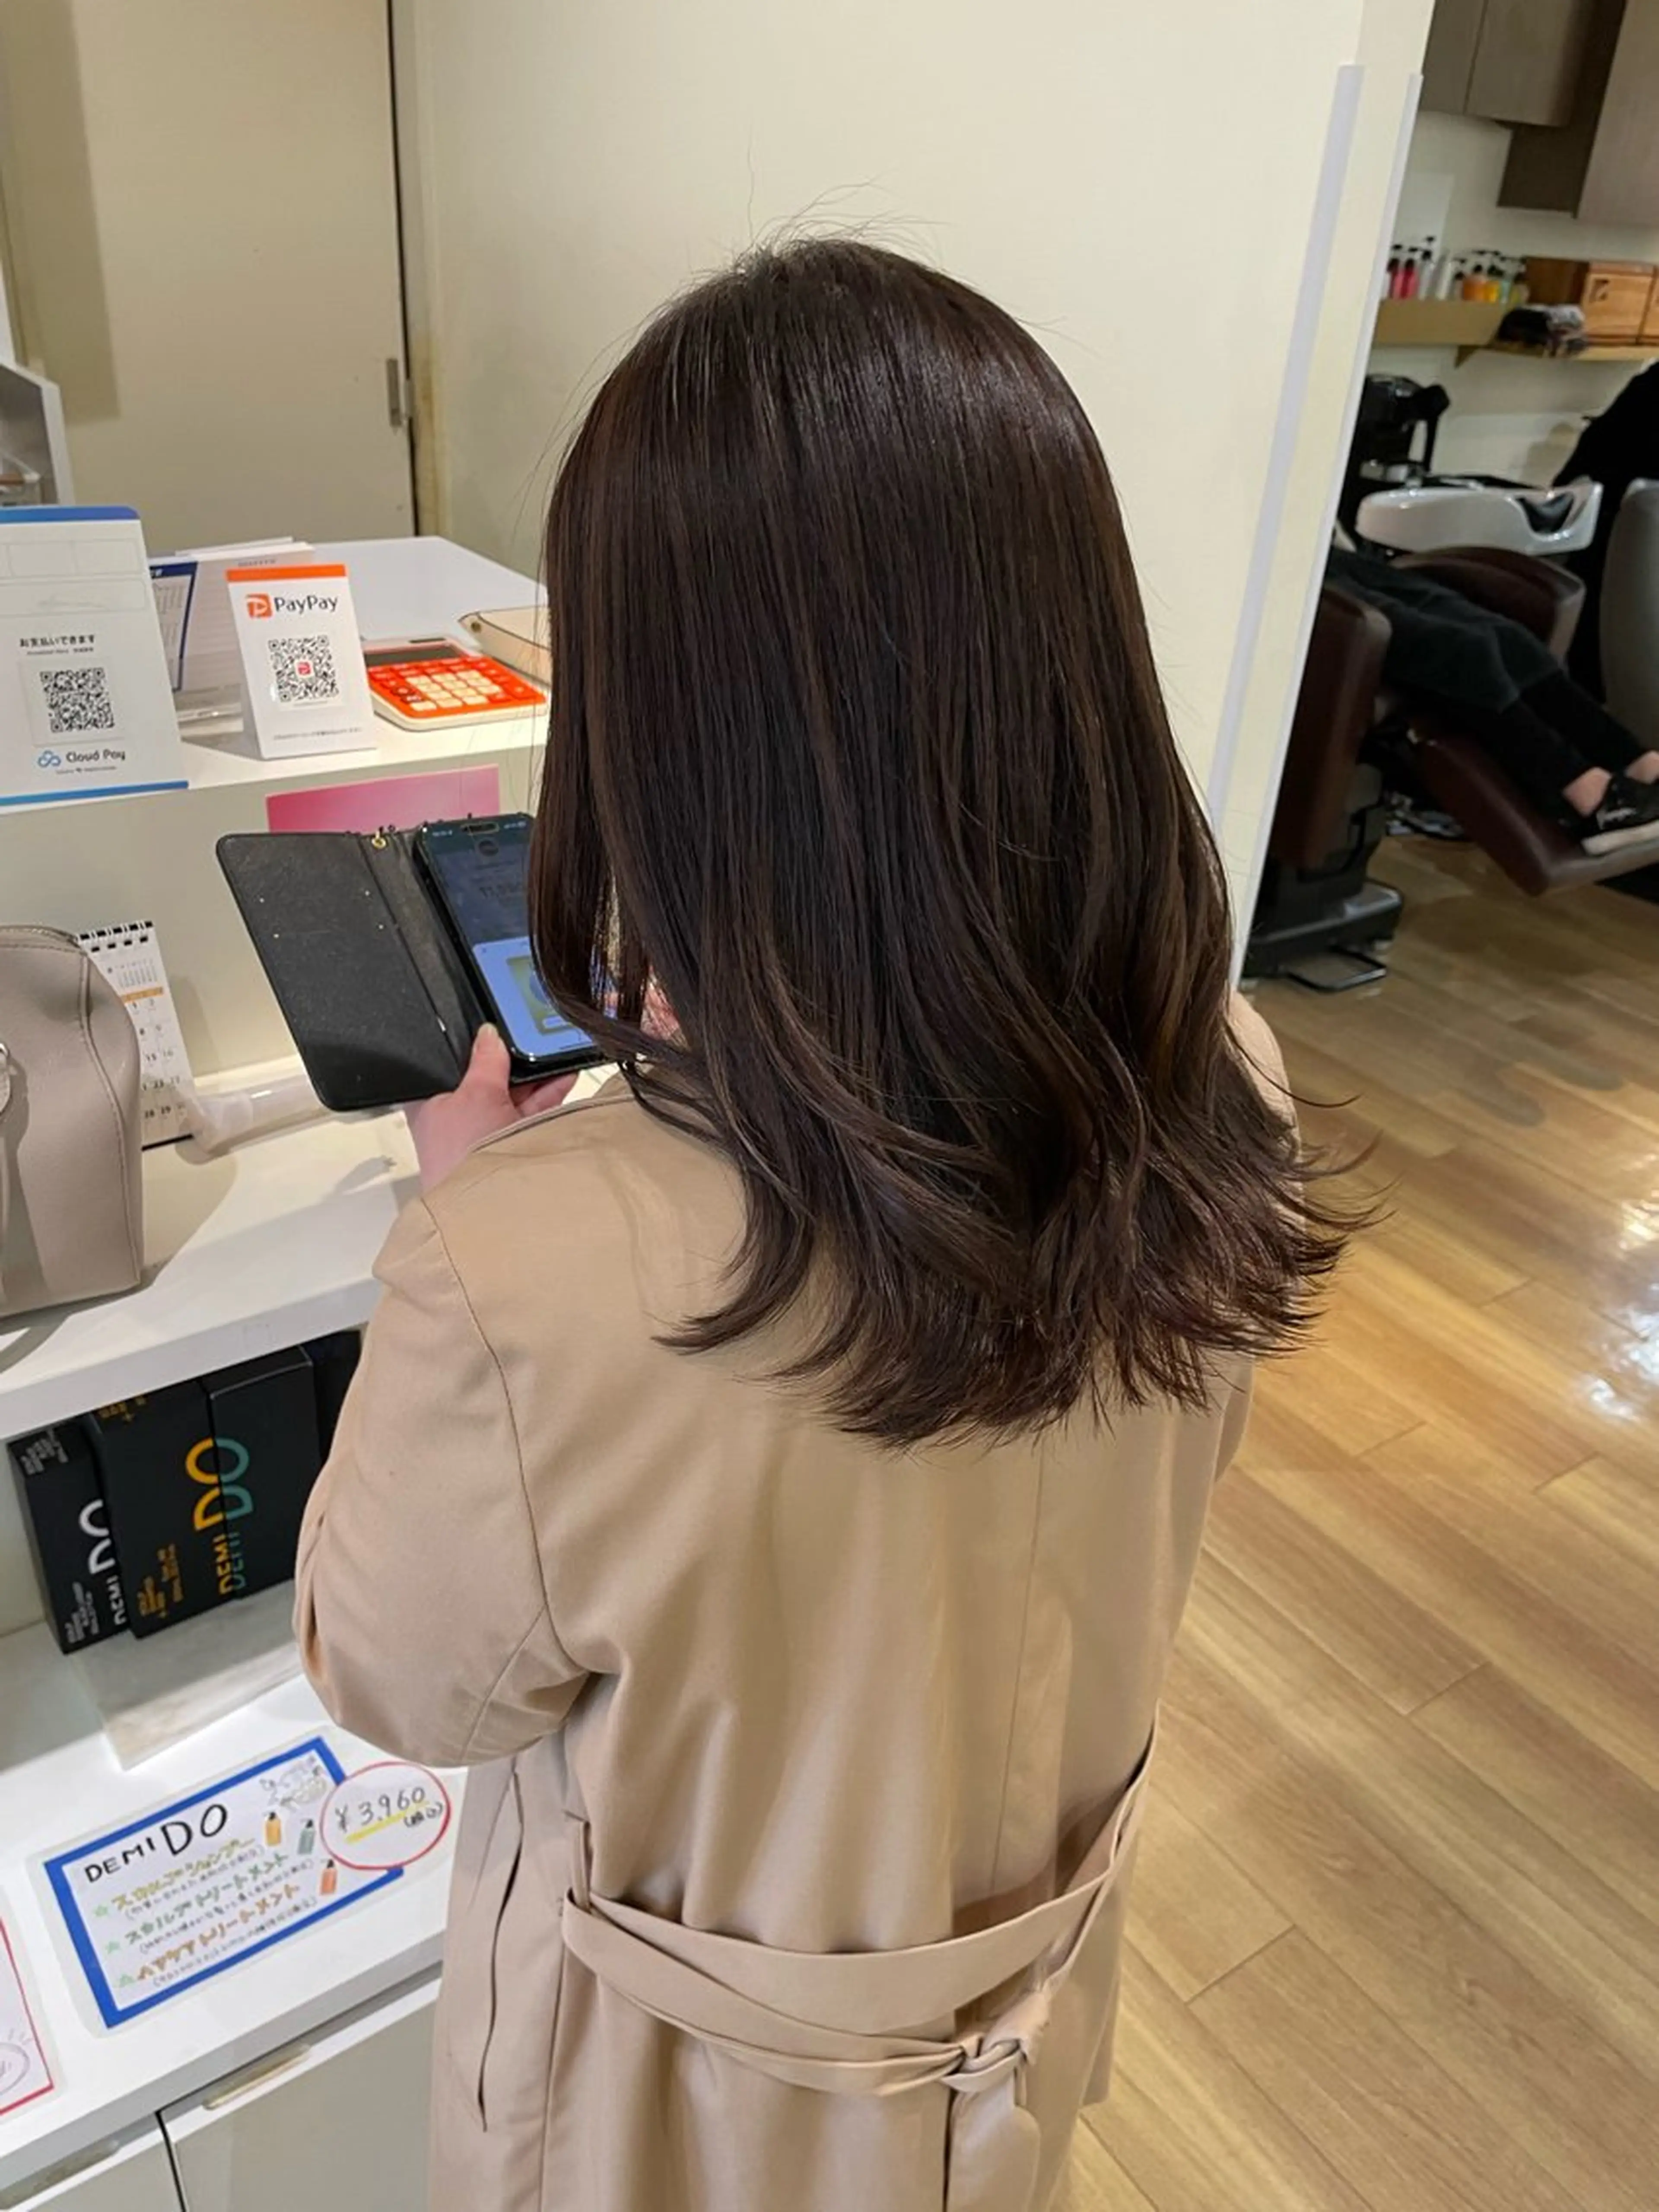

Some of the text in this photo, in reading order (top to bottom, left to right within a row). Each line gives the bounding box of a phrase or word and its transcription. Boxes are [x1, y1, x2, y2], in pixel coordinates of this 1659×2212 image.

[274, 594, 340, 615] PayPay
[66, 748, 126, 763] Cloud Pay
